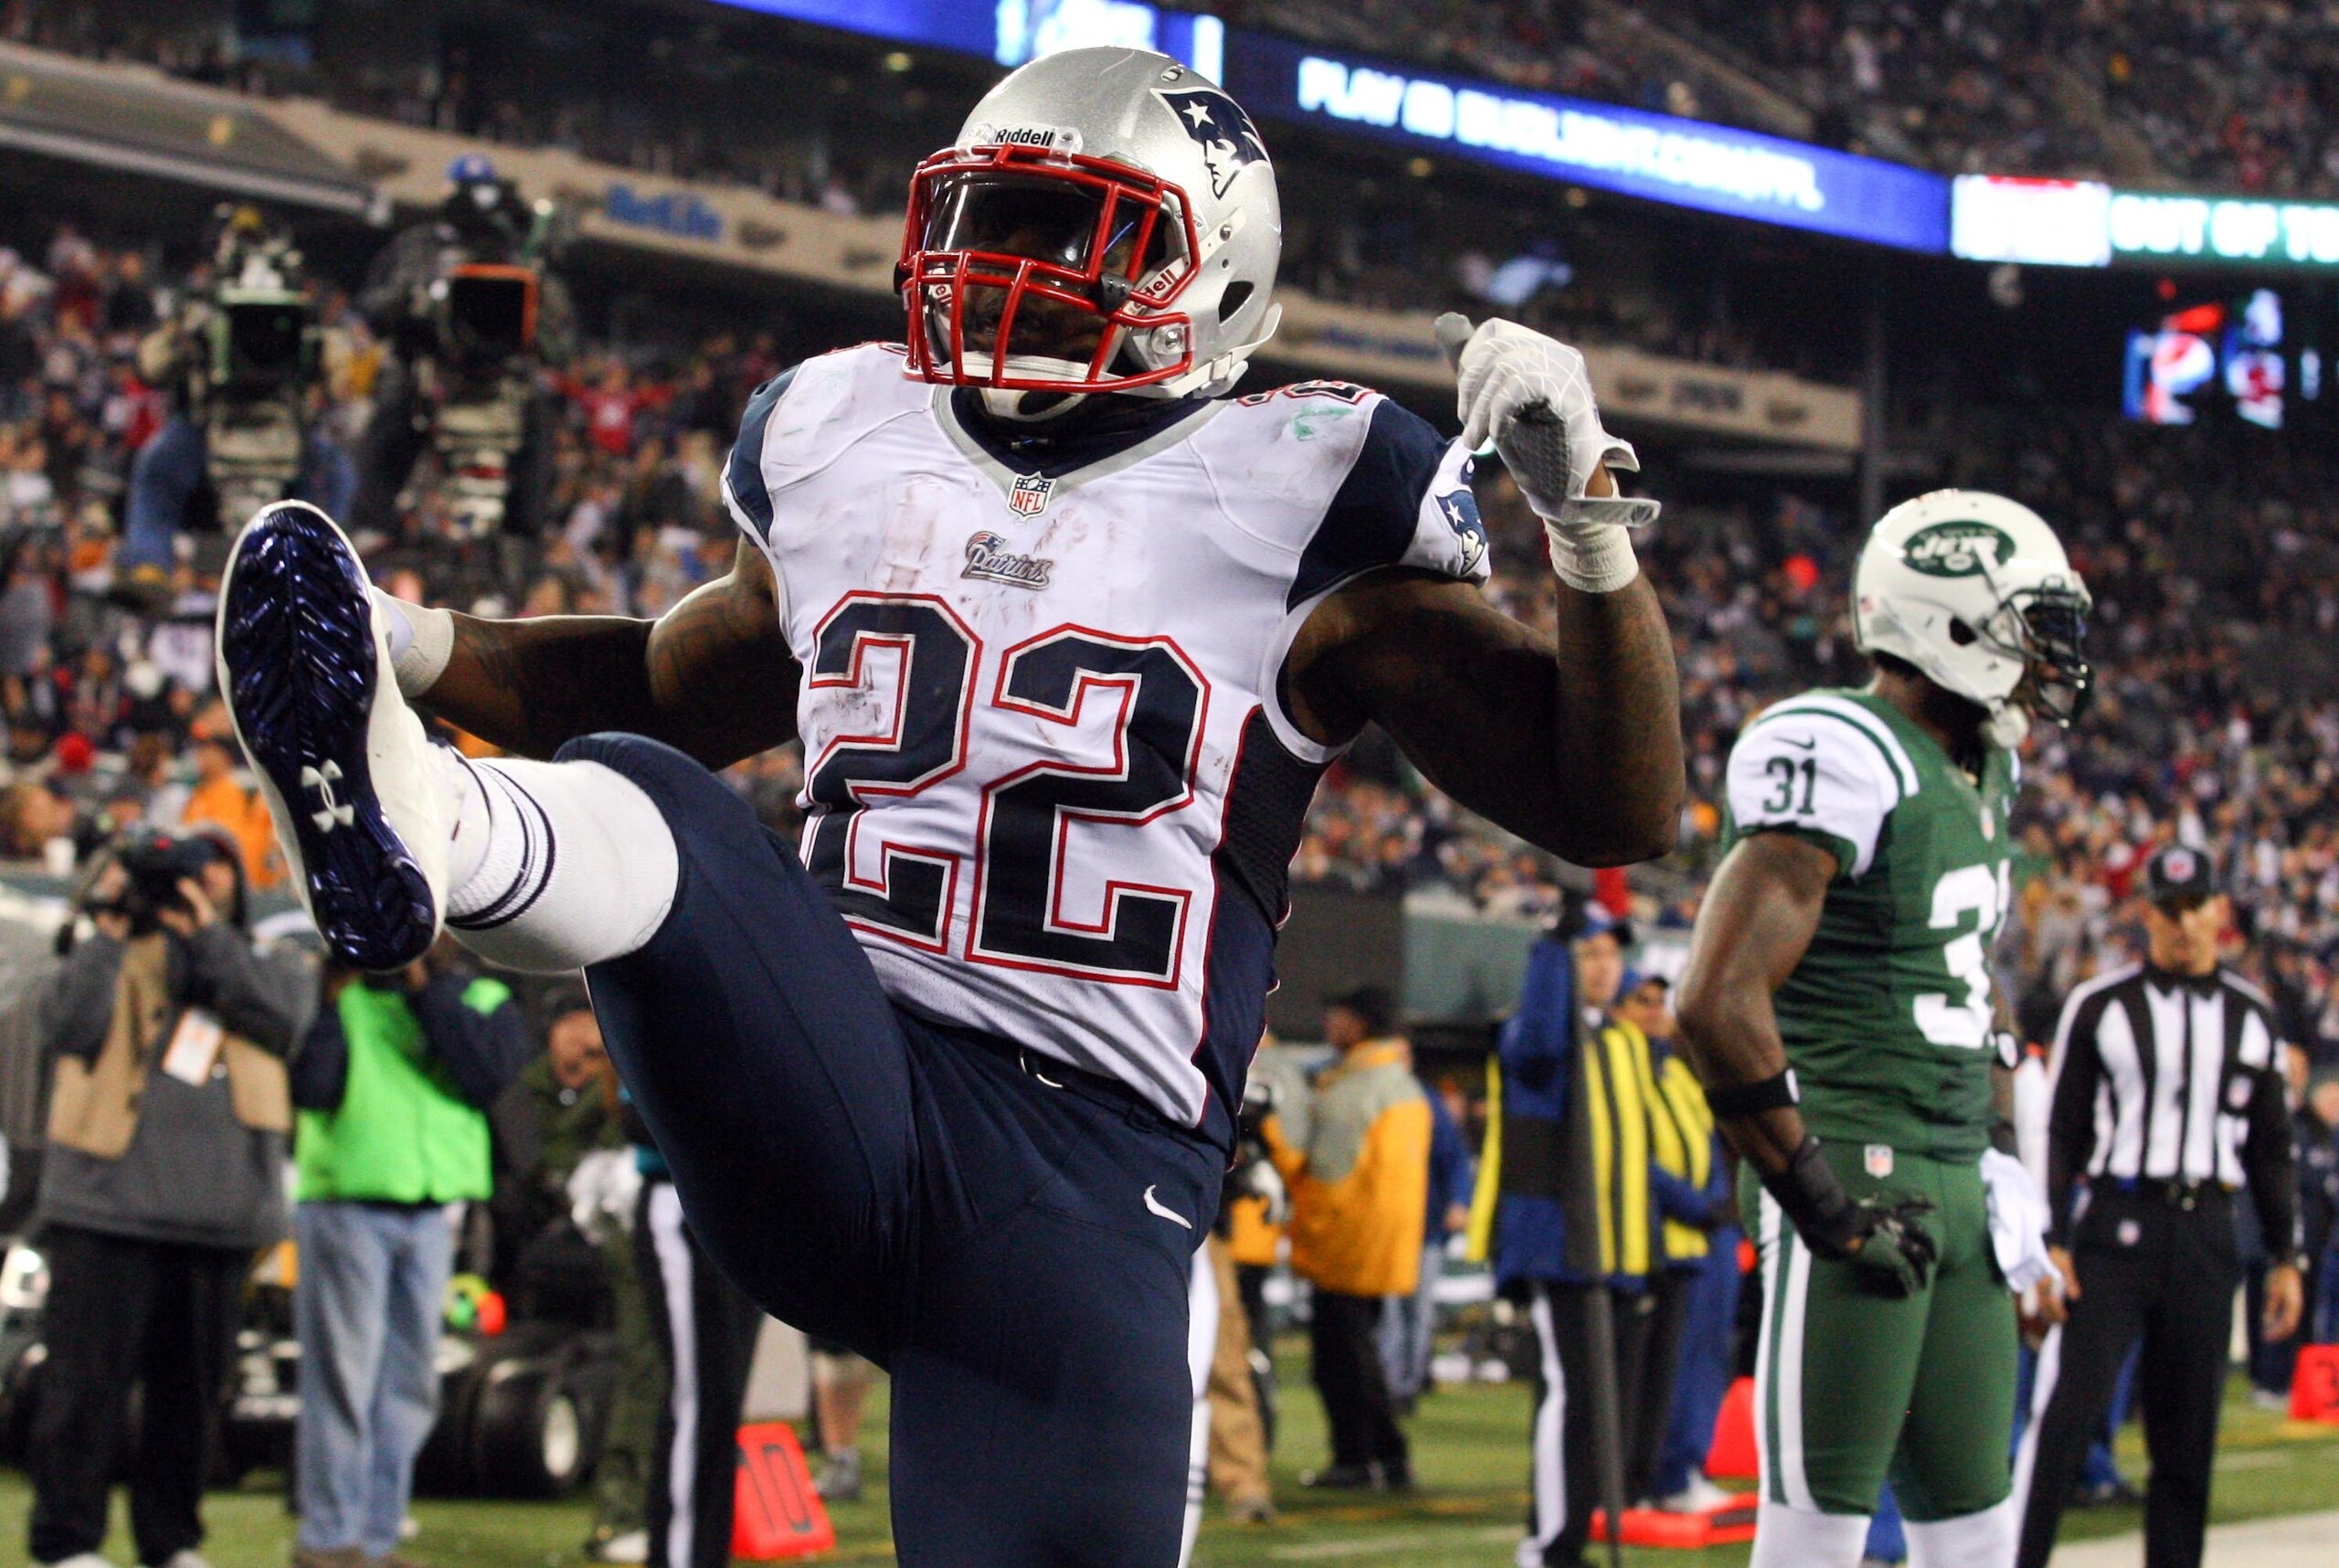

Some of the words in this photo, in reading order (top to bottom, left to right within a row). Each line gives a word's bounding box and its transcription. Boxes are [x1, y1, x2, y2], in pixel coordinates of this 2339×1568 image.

[995, 128, 1055, 147] Riddell
[1012, 490, 1042, 513] NFL
[961, 542, 1053, 588] Patriots
[800, 589, 1212, 991] 22
[1762, 758, 1817, 816] 31
